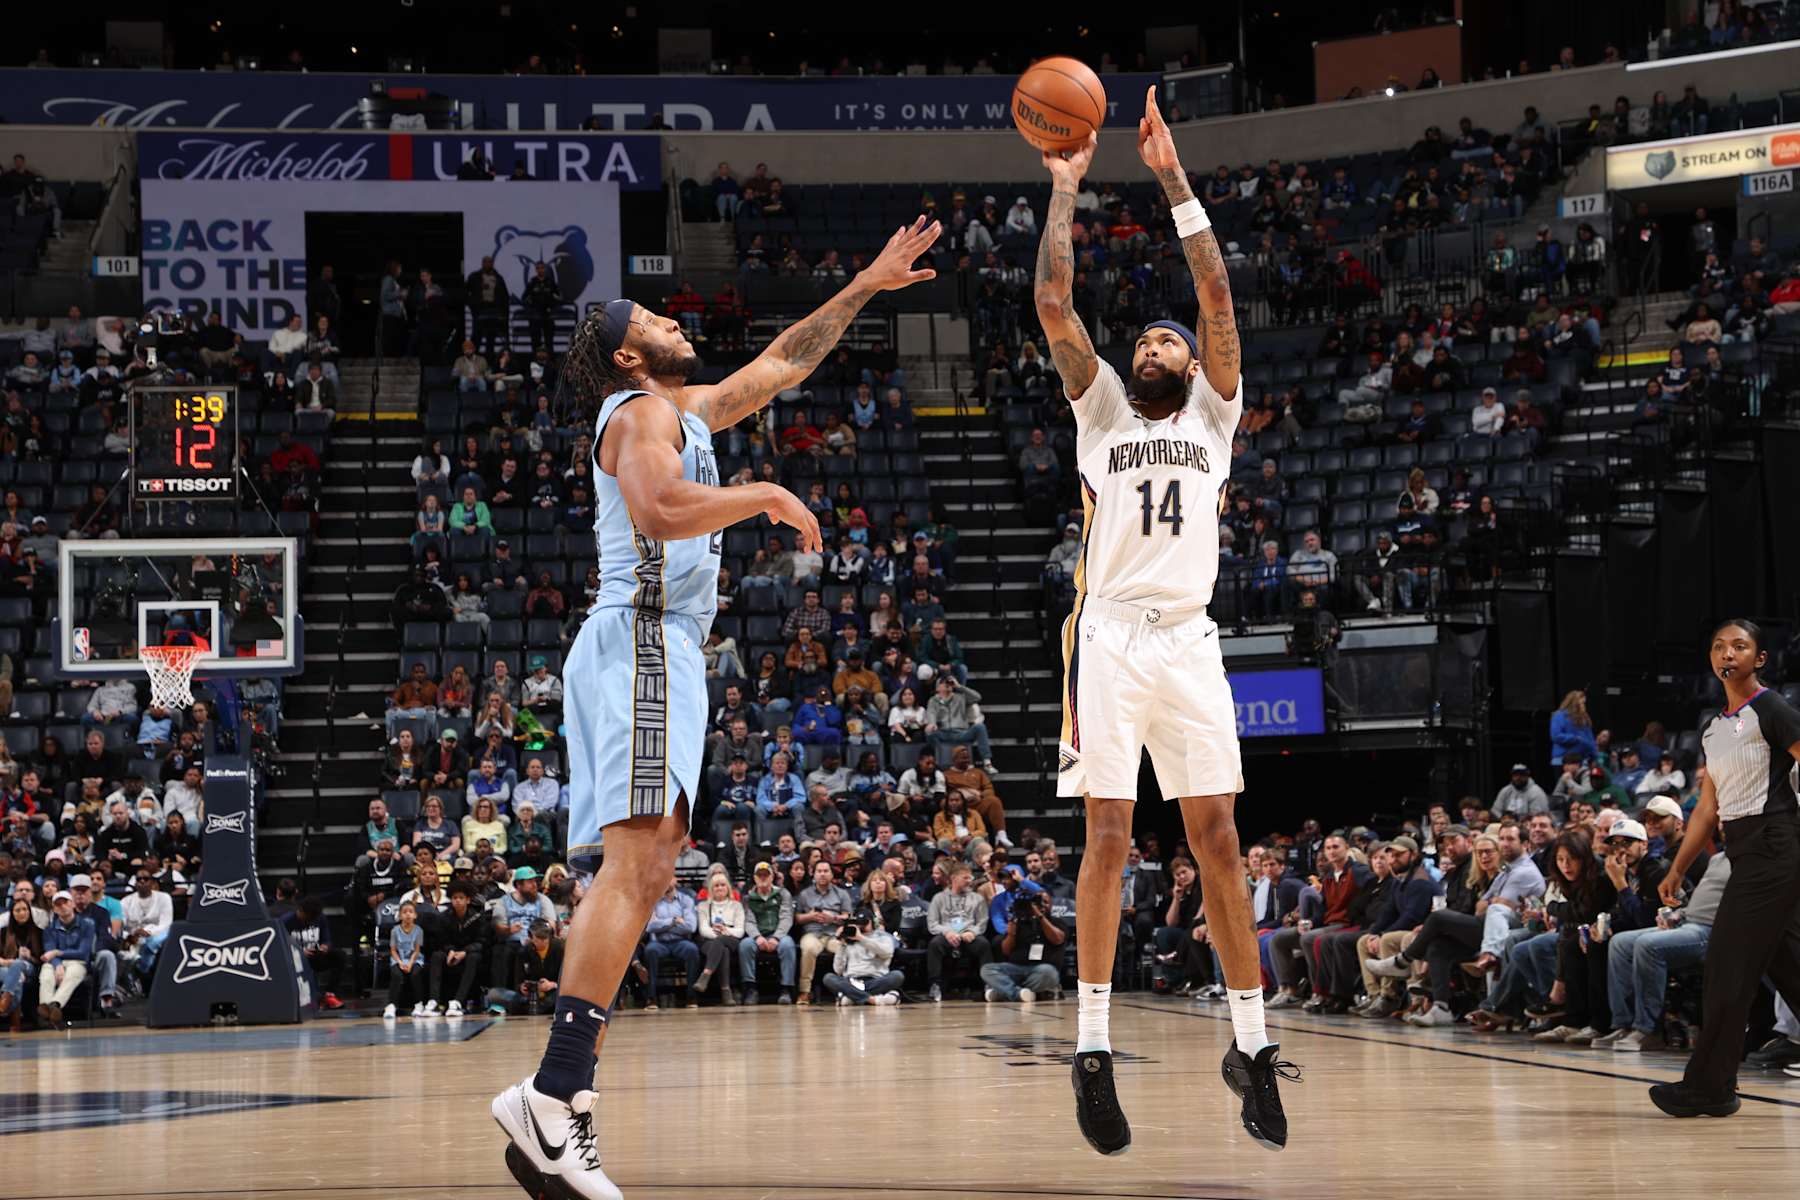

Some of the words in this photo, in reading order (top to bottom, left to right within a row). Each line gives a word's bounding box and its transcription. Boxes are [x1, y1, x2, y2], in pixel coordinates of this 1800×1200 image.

[835, 103, 886, 120] IT'S
[902, 104, 969, 120] ONLY
[1017, 98, 1072, 137] Wilson
[158, 139, 376, 181] Michelob
[1681, 151, 1740, 168] STREAM
[1745, 146, 1767, 160] ON
[1752, 175, 1790, 193] 116A
[1572, 197, 1596, 214] 117
[142, 219, 273, 252] BACK
[106, 259, 131, 274] 101
[640, 256, 665, 271] 118
[142, 258, 206, 291] TO
[217, 258, 306, 291] THE
[175, 396, 224, 423] 1:39
[175, 425, 216, 469] 12
[164, 478, 232, 492] TISSOT
[1135, 478, 1184, 537] 14
[210, 818, 240, 828] SONIC
[207, 887, 241, 898] SONIC
[187, 946, 260, 967] SONIC
